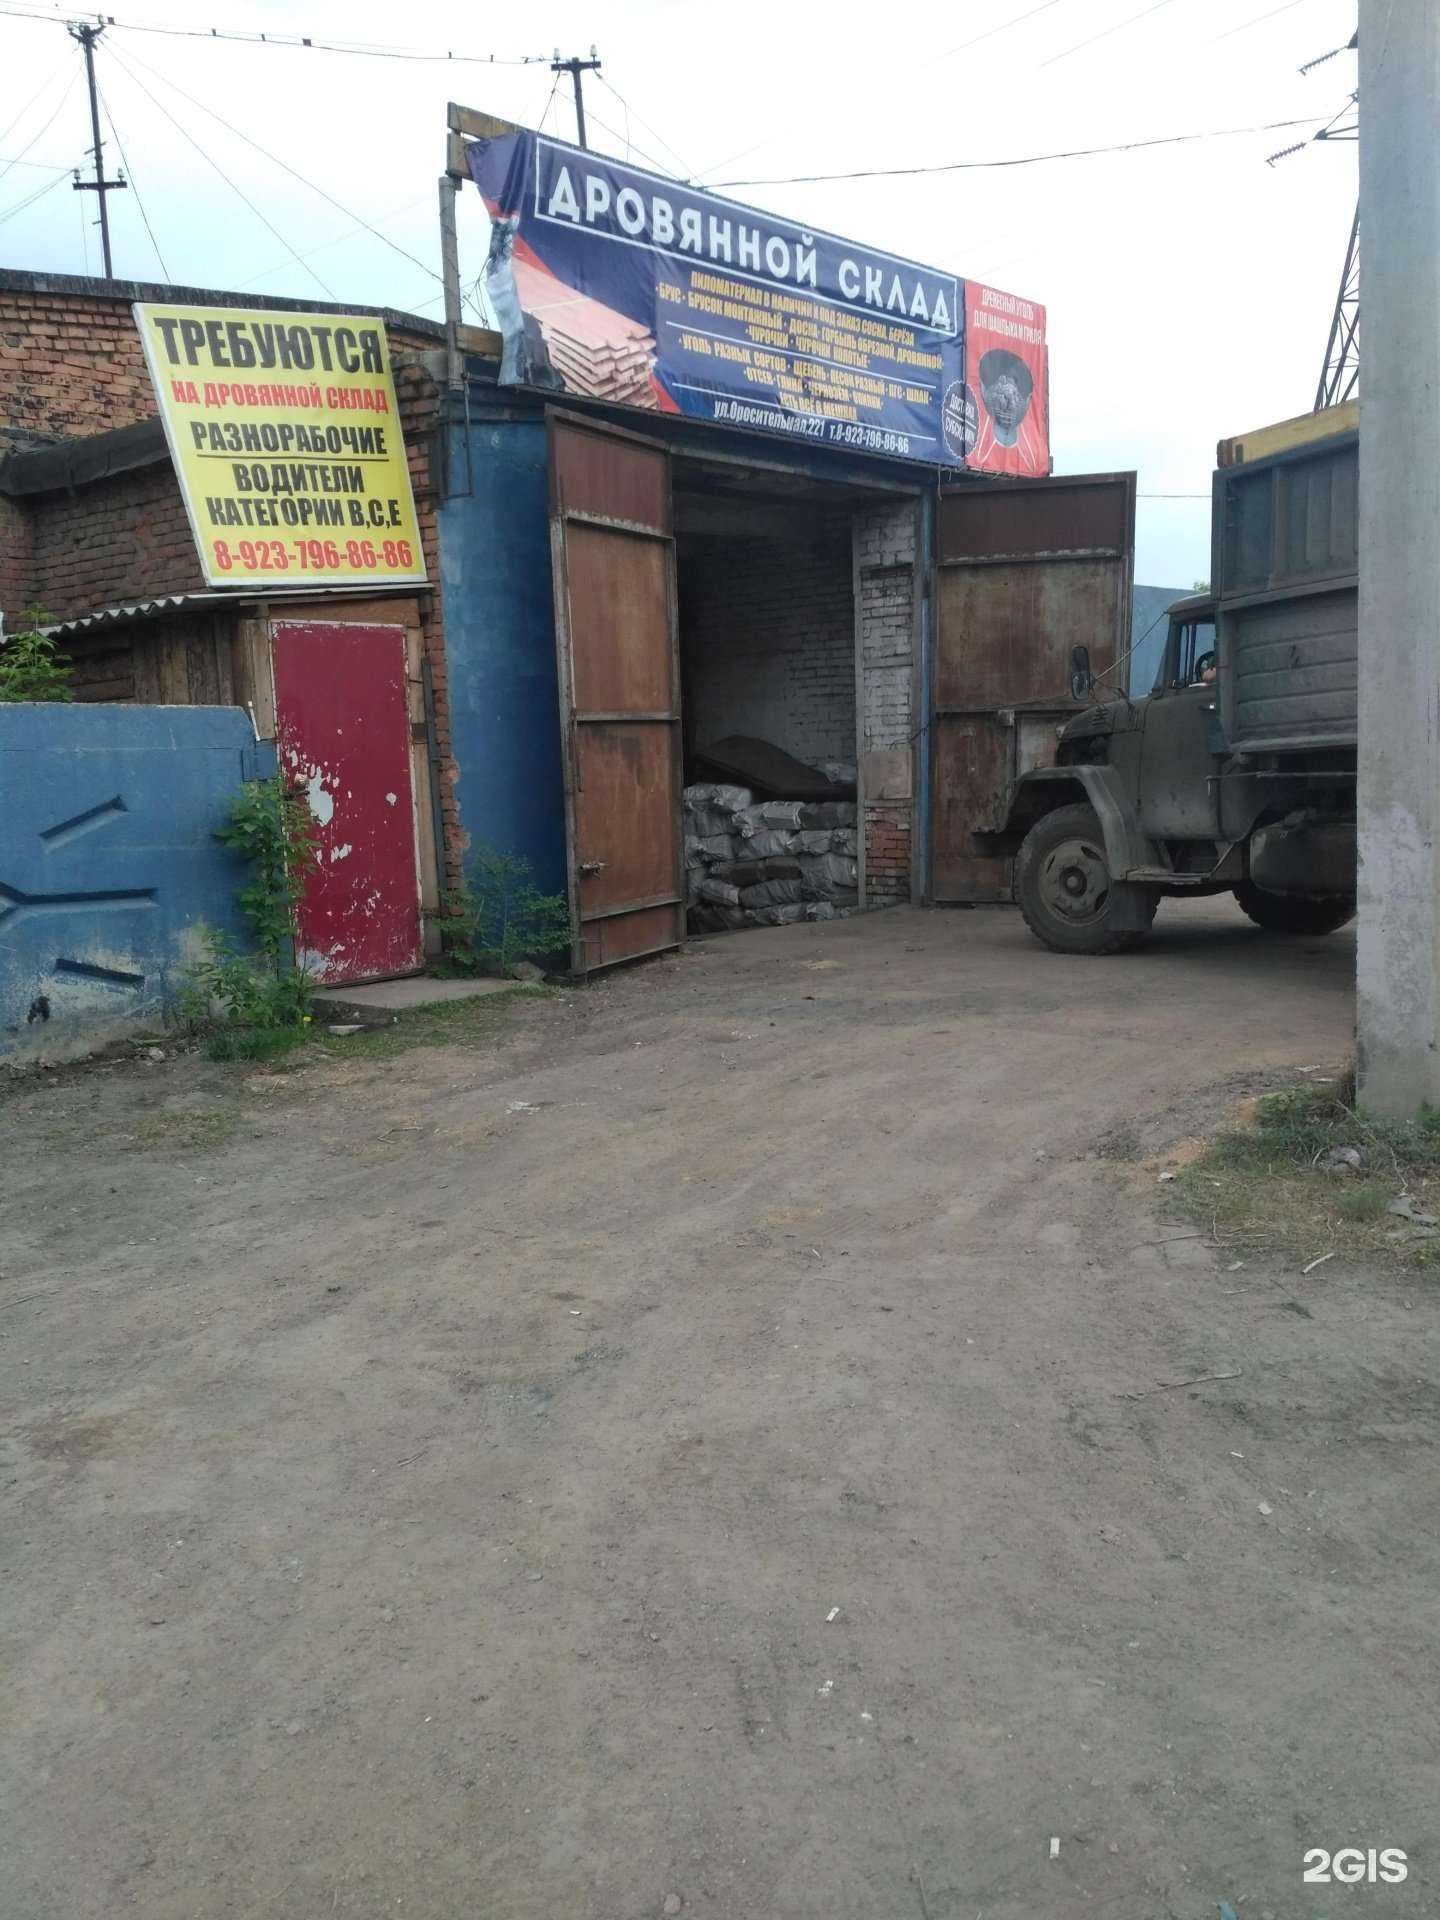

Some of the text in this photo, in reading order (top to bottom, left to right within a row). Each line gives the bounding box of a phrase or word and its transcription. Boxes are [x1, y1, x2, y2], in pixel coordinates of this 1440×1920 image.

[548, 166, 952, 329] ДРОВЯННОЙ СКЛАД
[688, 291, 723, 316] БРУСОК
[153, 317, 384, 374] ТРЕБУЮТСЯ
[714, 341, 751, 365] РАЗНЫХ
[171, 380, 389, 414] НА ДРОВЯННОЙ СКЛАД
[190, 421, 387, 455] РАЗНОРАБОЧИЕ
[232, 463, 365, 496] ВОДИТЕЛИ
[205, 496, 346, 527] КАТЕГОРИИ
[213, 539, 413, 570] 8-923-796-86-86
